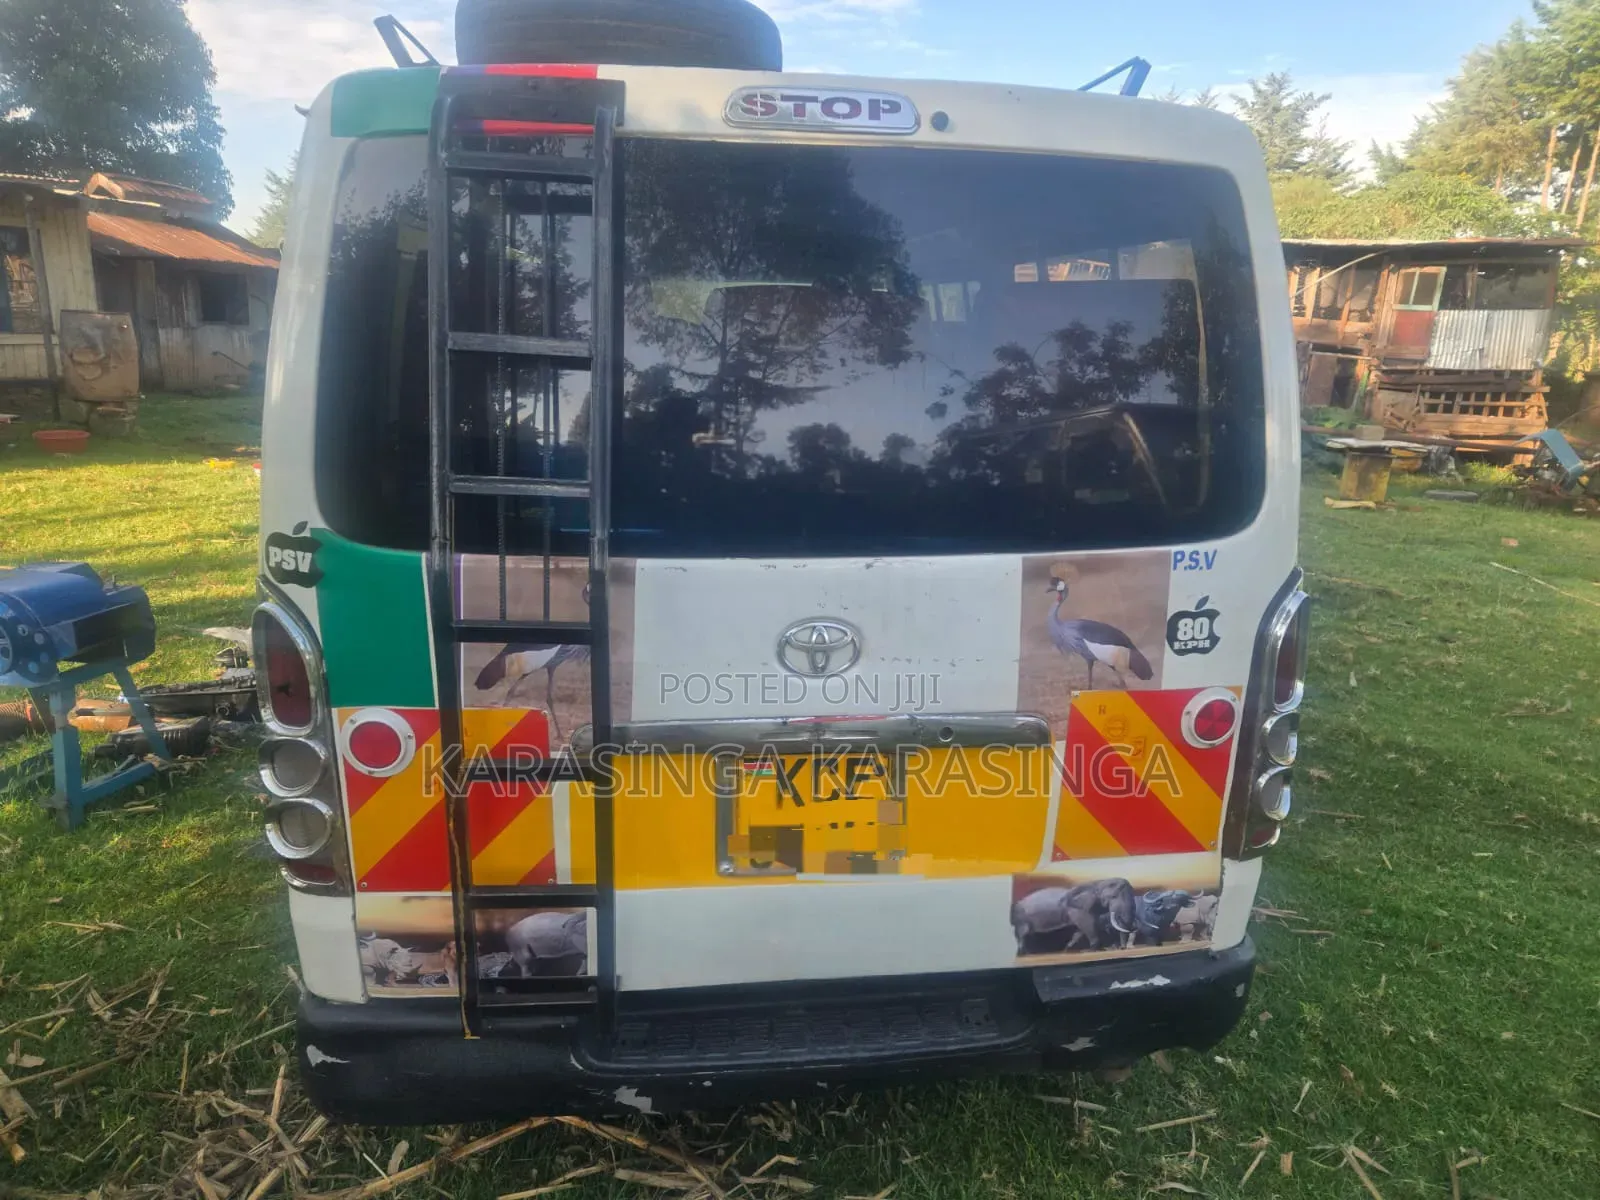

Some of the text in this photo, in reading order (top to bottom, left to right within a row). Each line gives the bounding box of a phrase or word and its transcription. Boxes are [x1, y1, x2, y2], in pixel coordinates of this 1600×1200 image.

[740, 93, 902, 121] STOP
[268, 546, 313, 573] PSV
[1172, 549, 1218, 571] P.S.V
[1177, 617, 1210, 641] 80
[1173, 640, 1210, 650] KPH
